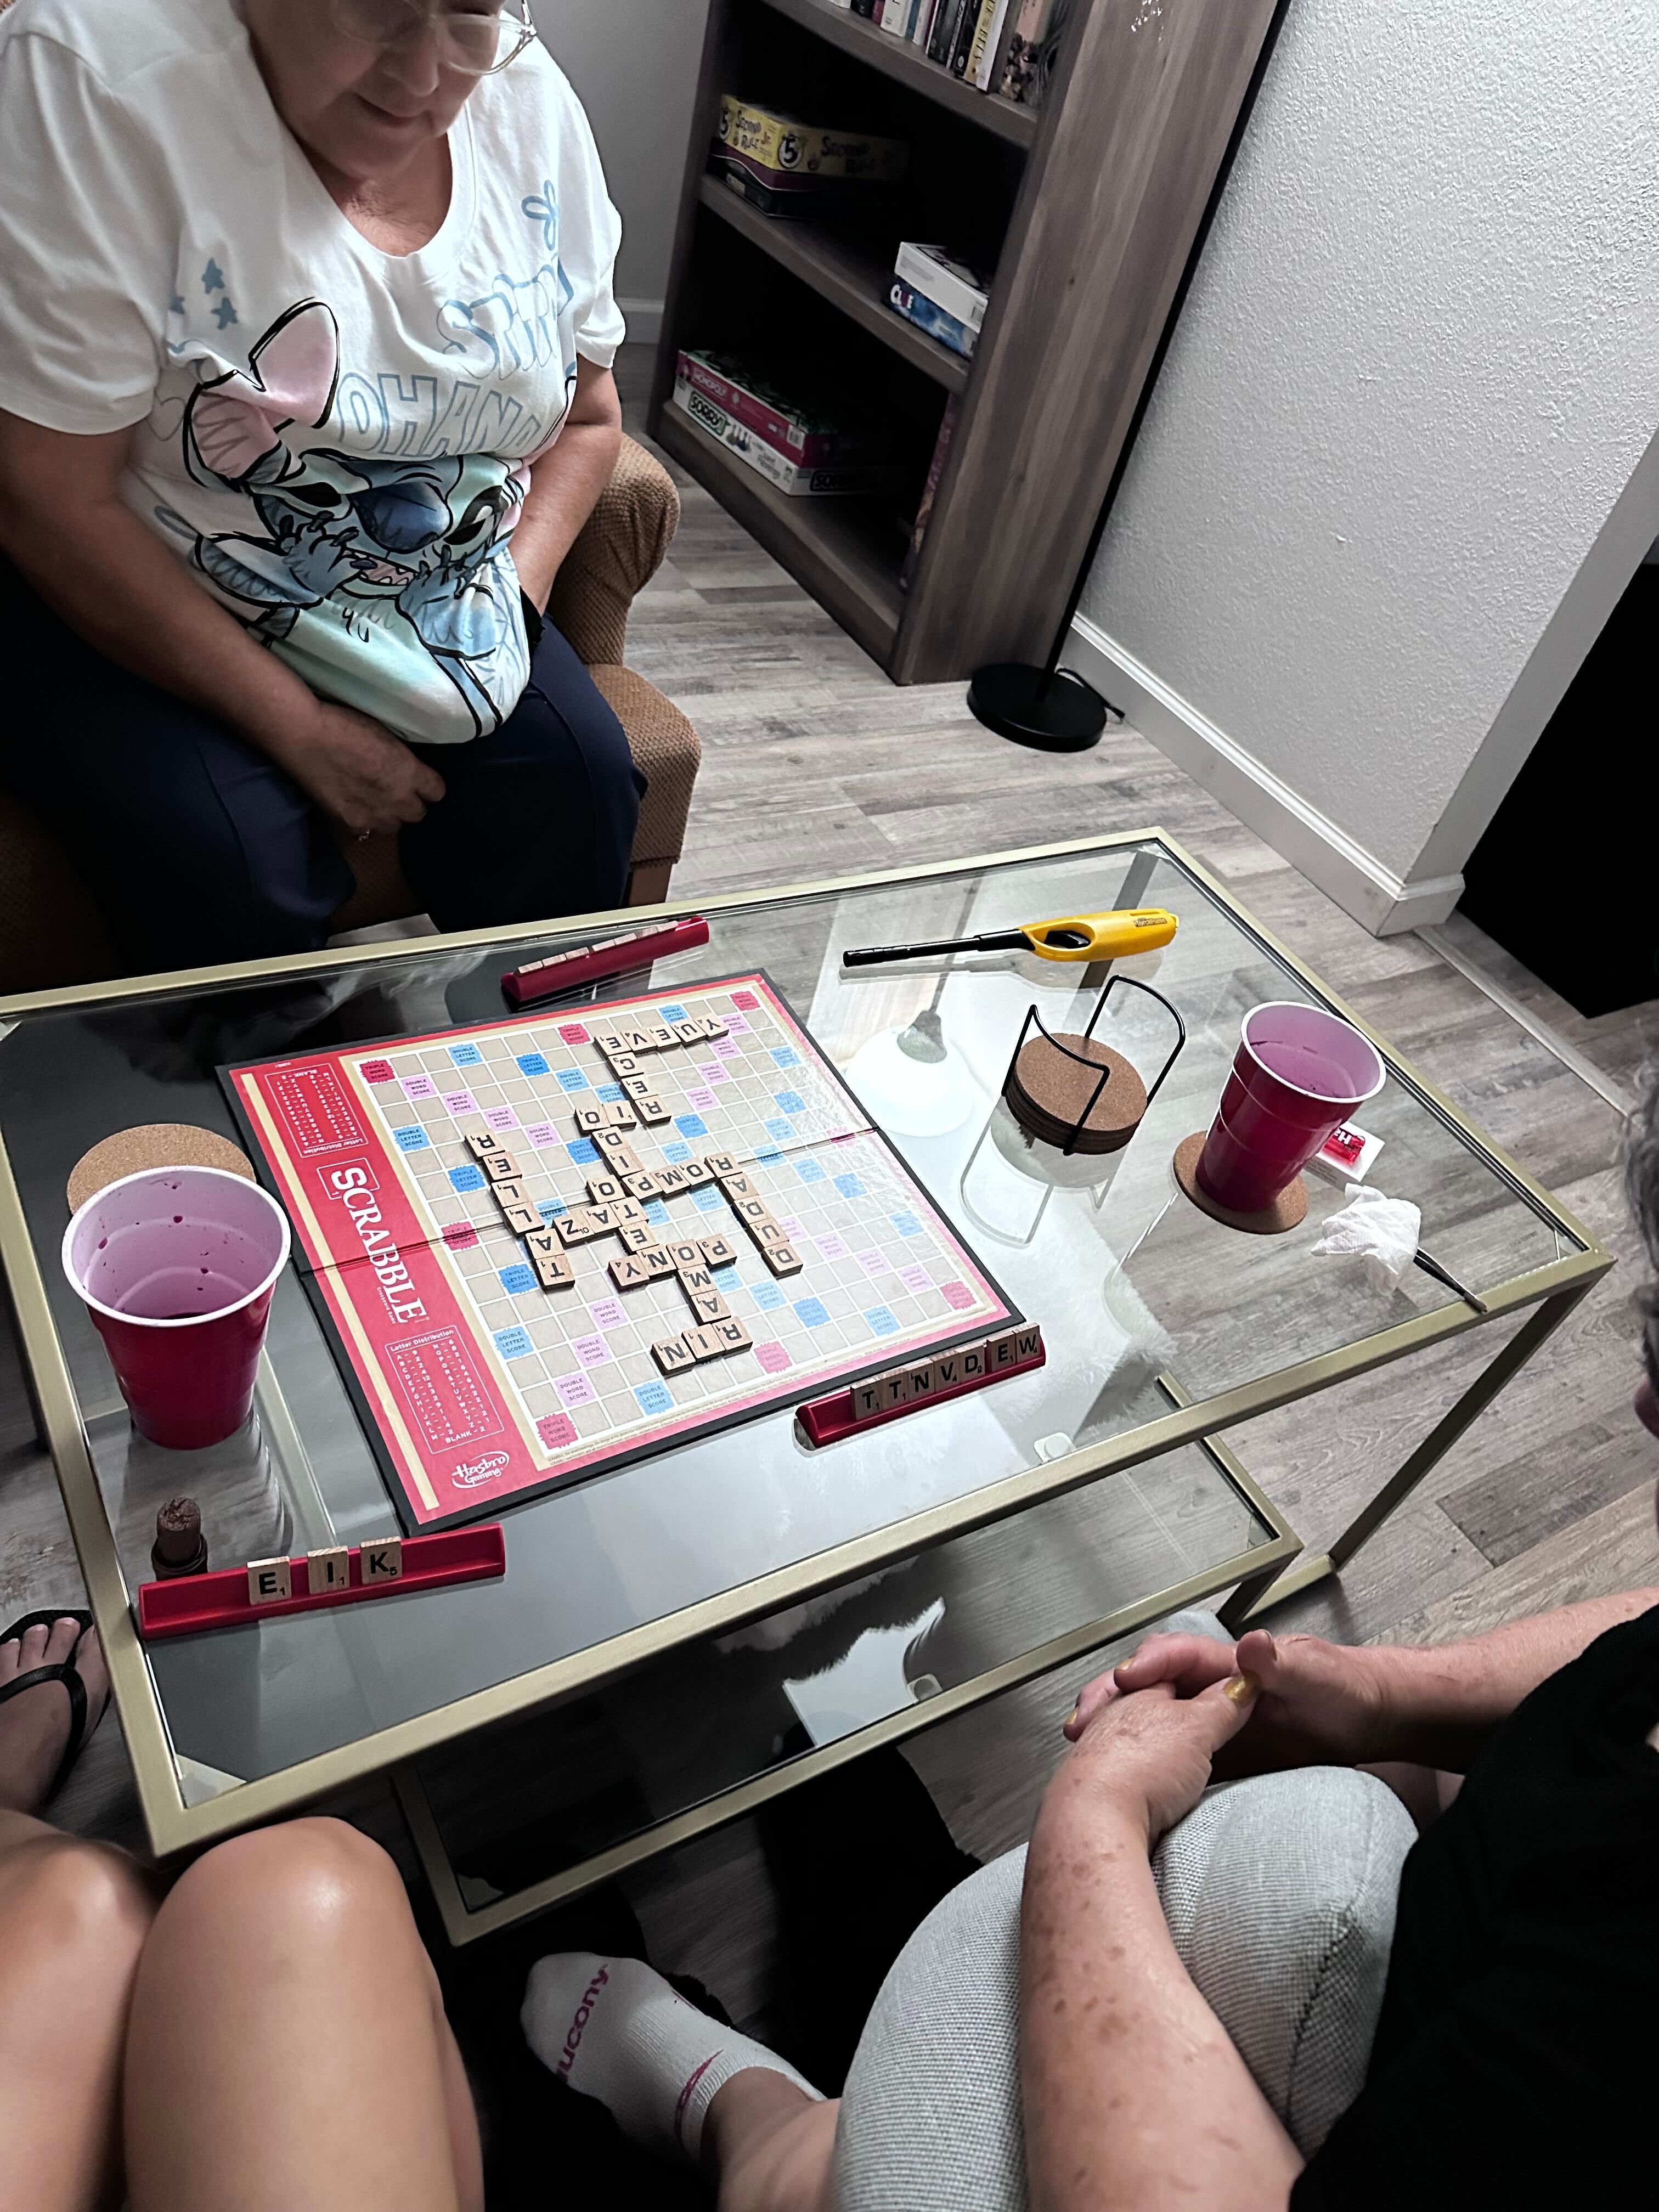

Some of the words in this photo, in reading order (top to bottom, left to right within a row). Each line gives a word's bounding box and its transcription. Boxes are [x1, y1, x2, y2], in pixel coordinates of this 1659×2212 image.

[783, 137, 798, 163] 5
[331, 1167, 427, 1323] SCRABBLE
[504, 1268, 524, 1277] TRIPLE
[506, 1274, 529, 1283] LETTER
[511, 1280, 531, 1288] SCORE
[594, 1302, 616, 1312] DOUBLE
[599, 1310, 616, 1318] WORD
[602, 1315, 621, 1324] SCORE
[390, 1341, 413, 1352] Letter
[413, 1329, 454, 1345] Distribution
[498, 1331, 522, 1341] DOUBLE
[501, 1337, 524, 1347] LETTER
[577, 1339, 600, 1350] DOUBLE
[506, 1344, 526, 1353] SCORE
[582, 1346, 600, 1355] WORD
[585, 1352, 605, 1361] SCORE
[560, 1378, 584, 1389] DOUBLE
[565, 1385, 583, 1394] WORD
[638, 1385, 662, 1396] DOUBLE
[568, 1391, 589, 1401] SCORE
[642, 1391, 665, 1402] LETTER
[647, 1398, 667, 1408] SCORE
[541, 1419, 564, 1429] TRIPLE
[547, 1426, 566, 1436] WORD
[445, 1430, 472, 1444] BLANK
[550, 1432, 571, 1442] SCORE
[453, 1455, 506, 1478] Hasbro
[464, 1467, 502, 1485] Gaming
